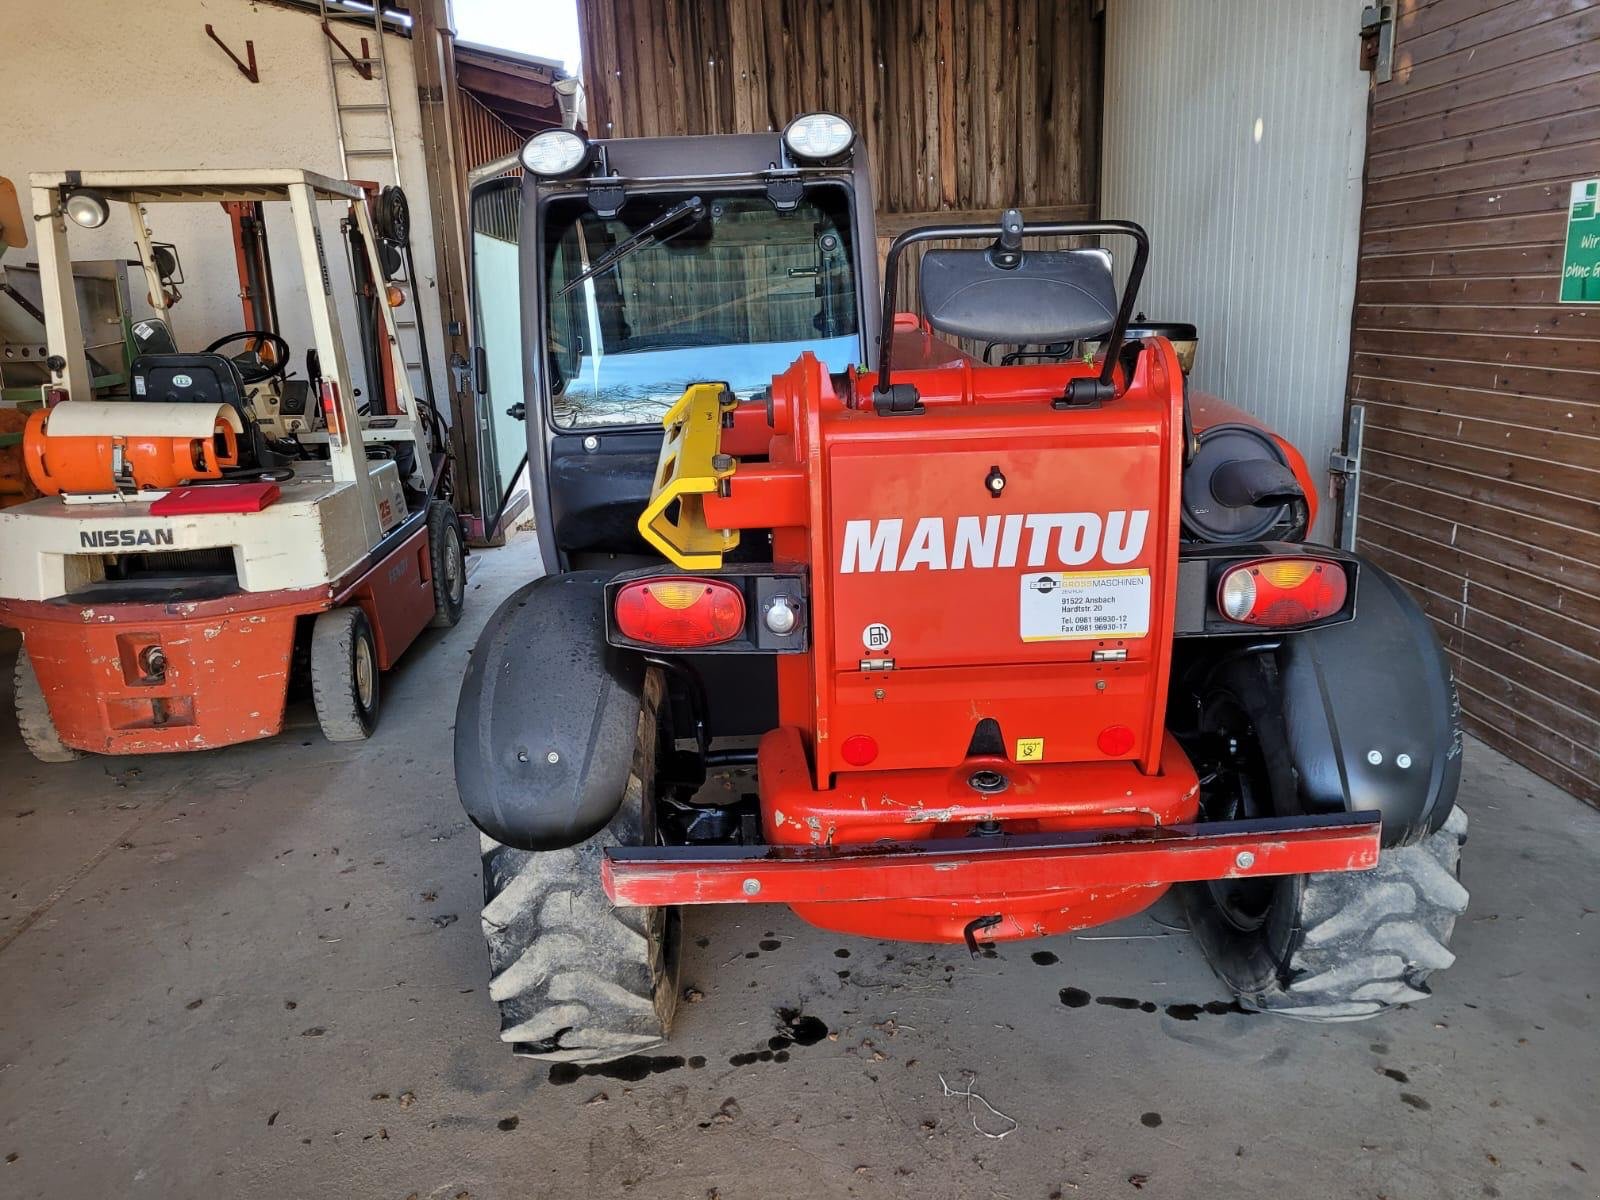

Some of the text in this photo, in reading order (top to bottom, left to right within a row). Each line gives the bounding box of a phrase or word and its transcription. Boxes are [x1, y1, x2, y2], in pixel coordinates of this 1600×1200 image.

[1565, 262, 1590, 277] ohne
[80, 528, 174, 547] NISSAN
[840, 510, 1150, 573] MANITOU
[1061, 596, 1116, 605] 91522 Ansbach
[1061, 605, 1092, 613] Hardtstr.
[1075, 616, 1092, 624] 0981
[1094, 615, 1128, 623] 96930-12
[1075, 624, 1092, 632] 0981
[1094, 623, 1128, 631] 96930-17
